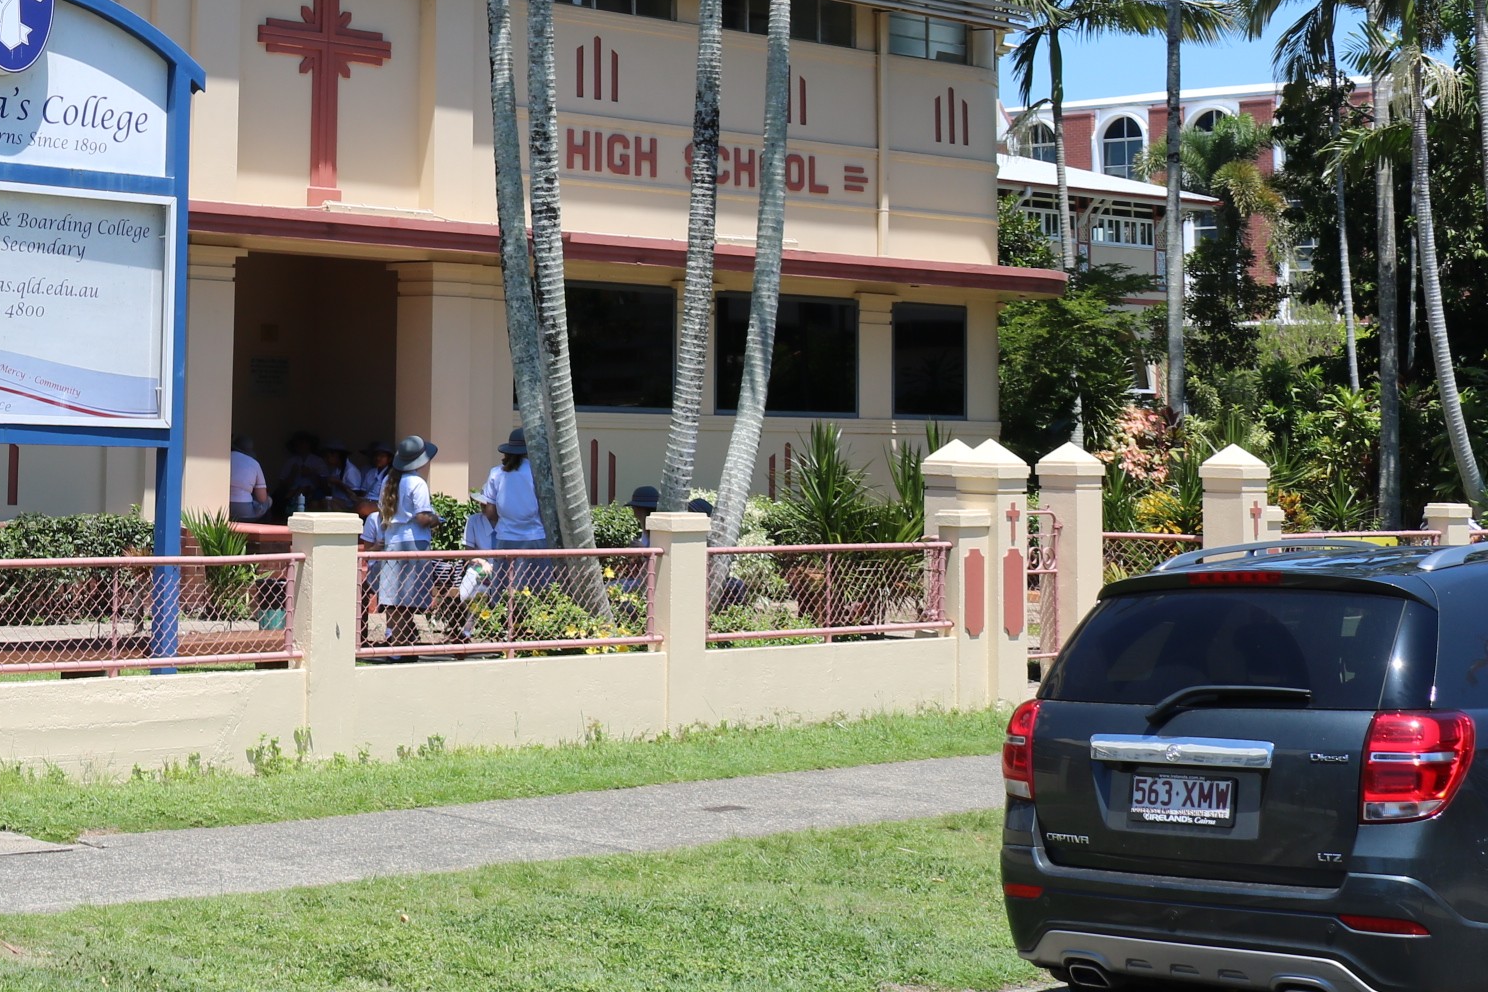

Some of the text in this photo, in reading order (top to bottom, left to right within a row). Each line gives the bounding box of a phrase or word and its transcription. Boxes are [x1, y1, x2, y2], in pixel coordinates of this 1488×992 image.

[42, 94, 148, 143] College
[28, 131, 69, 149] Since
[74, 138, 107, 154] 1890
[567, 128, 829, 194] HIGH CHOL
[17, 212, 92, 239] Boarding
[97, 219, 150, 240] College
[1, 236, 86, 262] Secondary
[5, 302, 45, 319] 4800
[0, 364, 25, 380] Mercy
[34, 375, 82, 398] Community
[1046, 832, 1089, 844] CAPTIVA
[1317, 852, 1342, 862] LTZ
